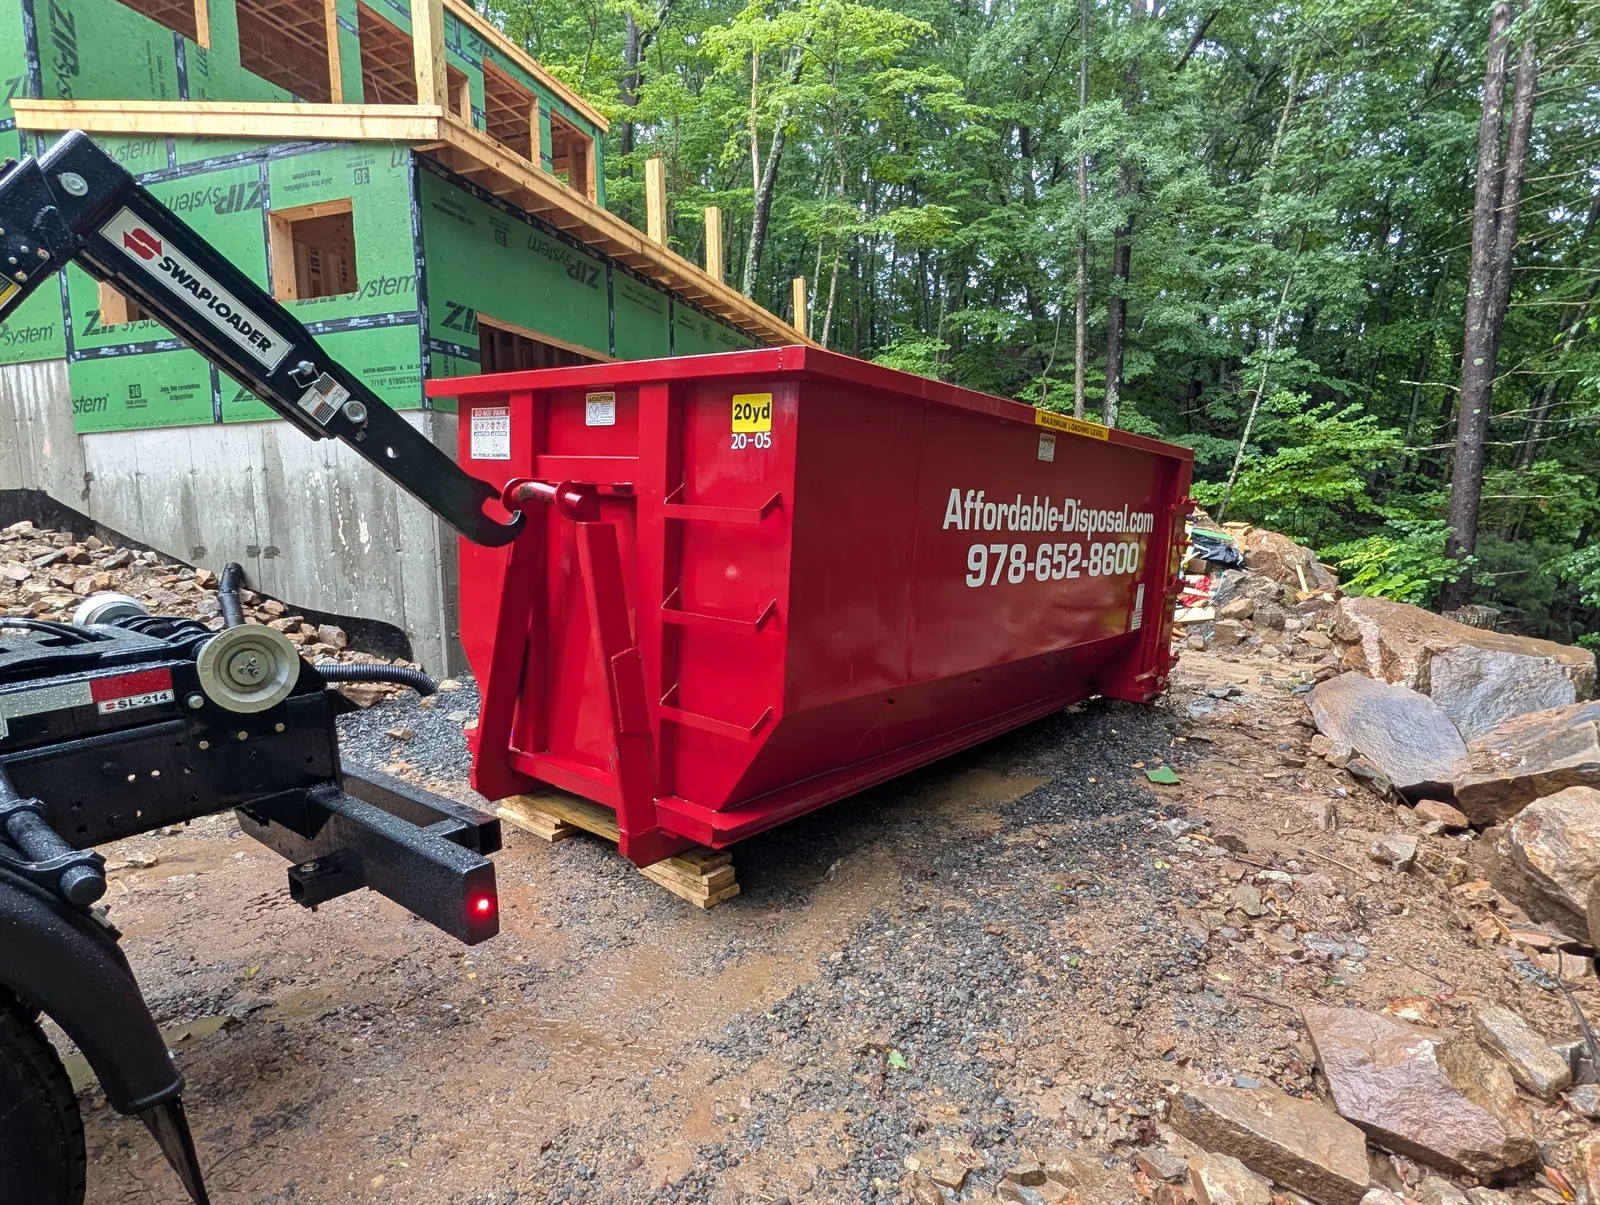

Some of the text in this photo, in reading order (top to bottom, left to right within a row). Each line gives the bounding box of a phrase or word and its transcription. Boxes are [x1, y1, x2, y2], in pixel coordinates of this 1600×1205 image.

[158, 256, 273, 353] SWAPLOADER
[493, 409, 507, 417] PARK
[734, 401, 771, 424] 20yd
[1041, 415, 1105, 439] MAXIMUM LOADING LEVEL
[731, 432, 772, 450] 20-05
[942, 487, 1154, 541] Affordable-Disposal.com
[965, 542, 1140, 588] 978-652-8600
[117, 692, 168, 709] SL-214
